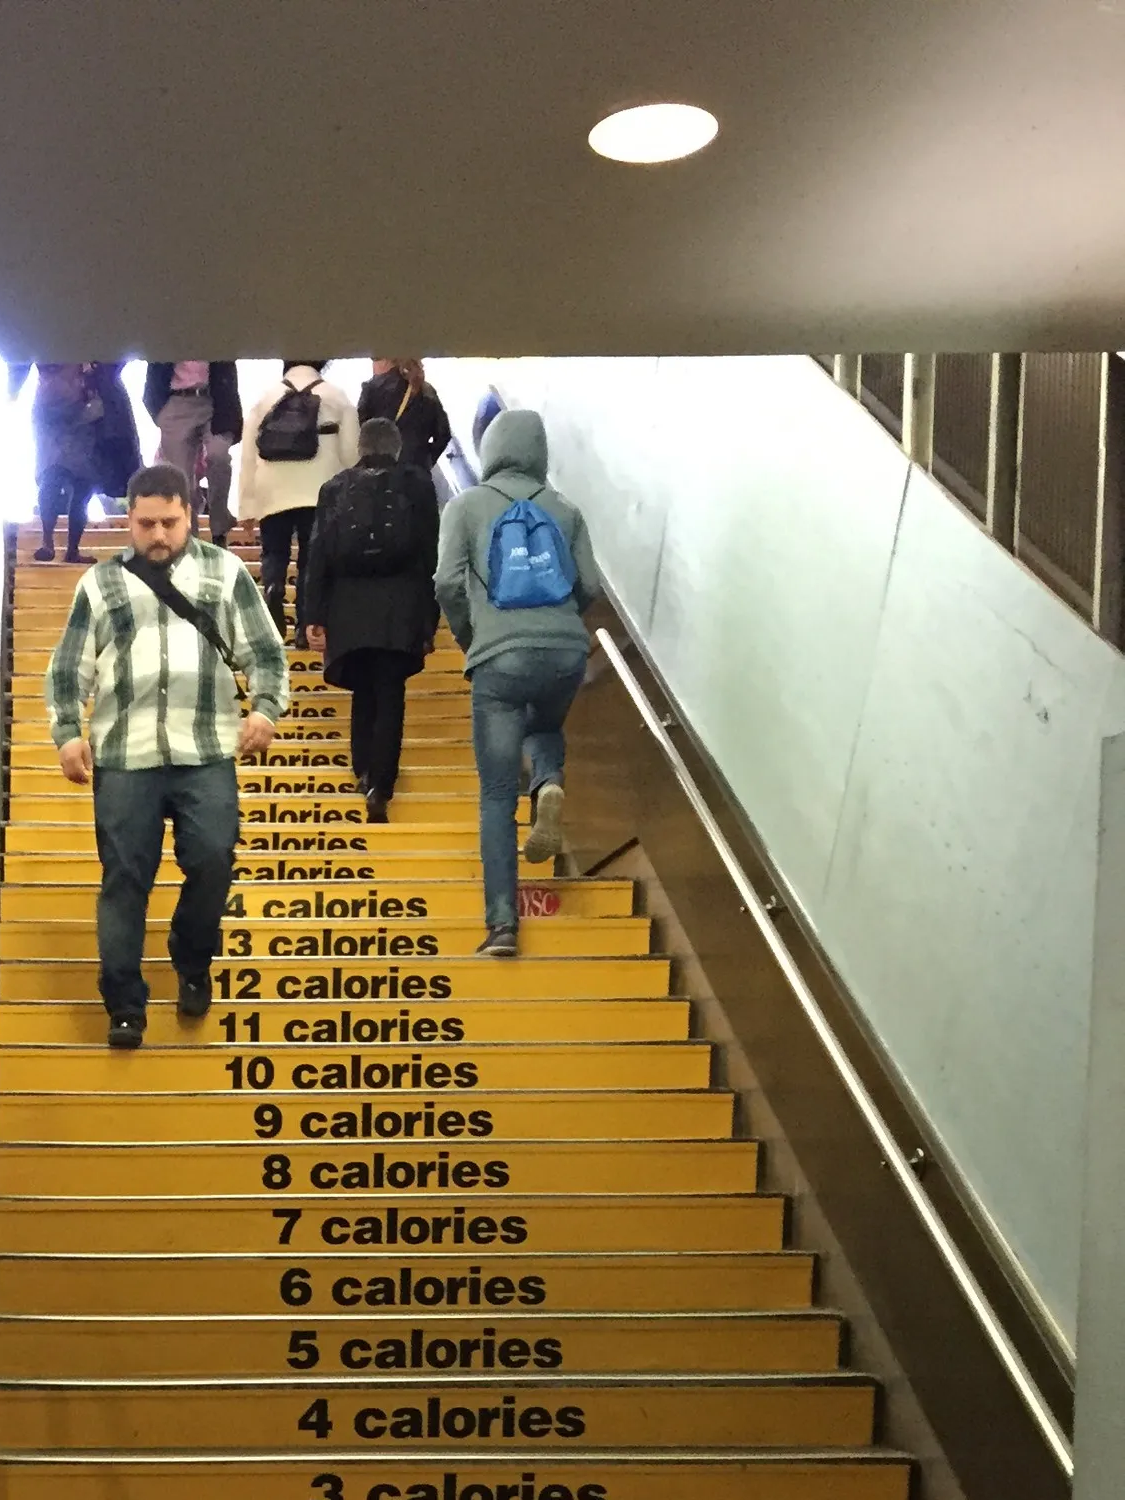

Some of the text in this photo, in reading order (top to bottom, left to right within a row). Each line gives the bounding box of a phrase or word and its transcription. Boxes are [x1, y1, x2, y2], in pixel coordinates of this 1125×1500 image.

[232, 748, 349, 767] alories
[237, 776, 355, 794] alories
[263, 890, 428, 918] calories
[268, 927, 439, 957] calories
[214, 966, 452, 1000] 12 calories
[219, 1010, 465, 1043] 11 calories
[225, 1054, 479, 1090] 10 calories
[253, 1102, 494, 1139] 9 calories
[262, 1152, 510, 1189] 8 calories
[272, 1207, 528, 1245] 7 calories
[280, 1266, 546, 1307] 6 calories
[287, 1328, 563, 1370] 5 calories
[298, 1396, 586, 1439] 4 calories
